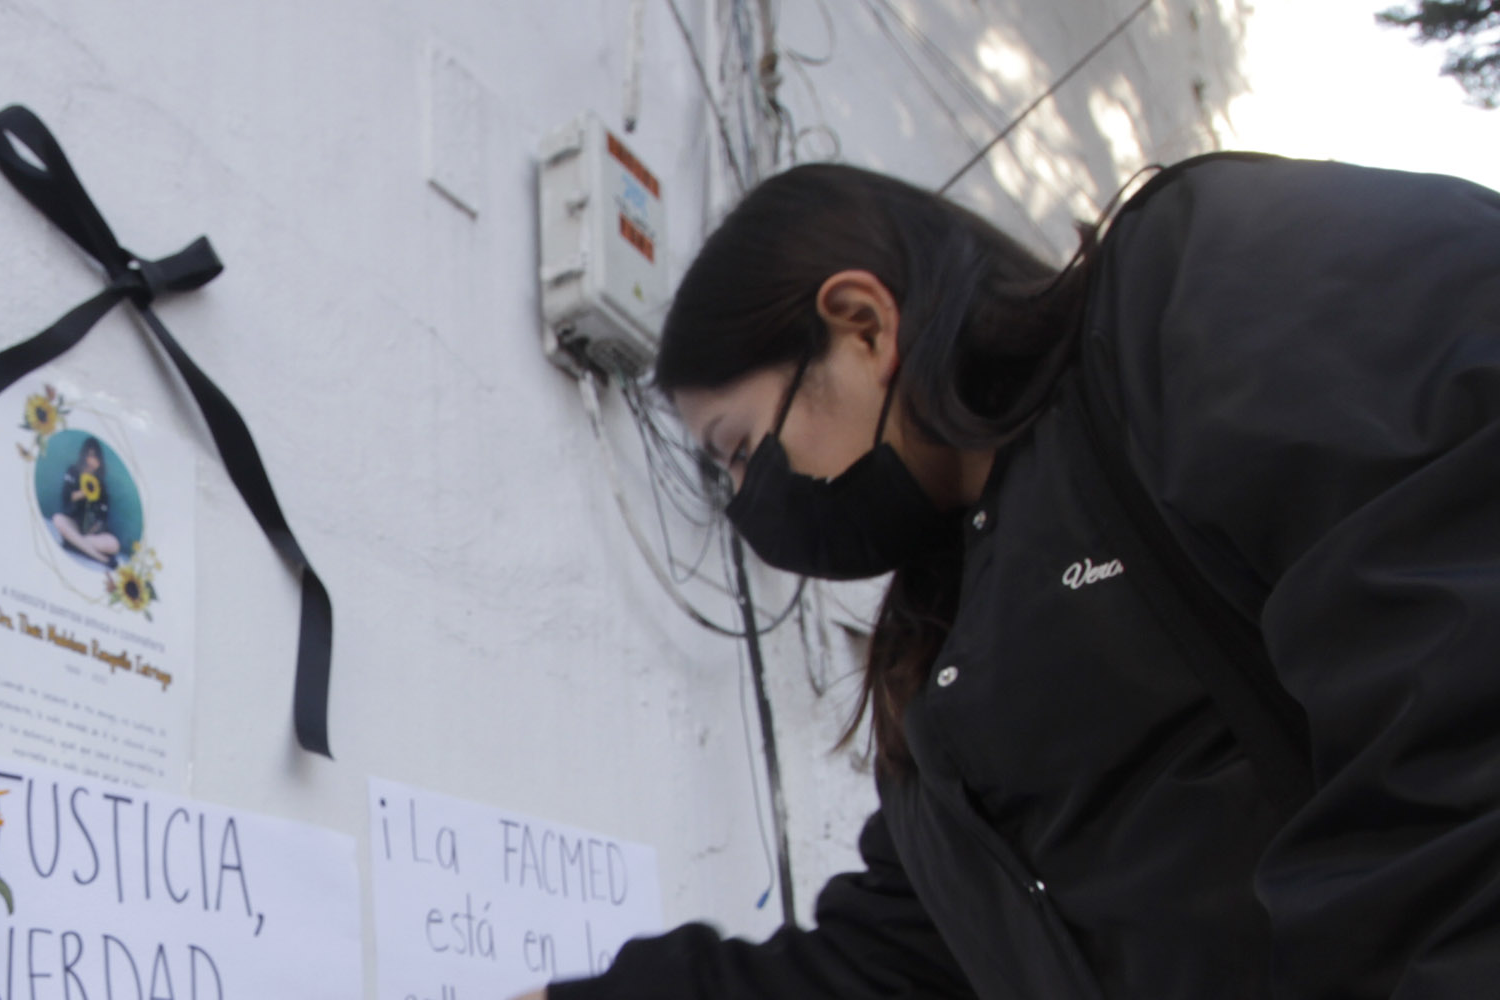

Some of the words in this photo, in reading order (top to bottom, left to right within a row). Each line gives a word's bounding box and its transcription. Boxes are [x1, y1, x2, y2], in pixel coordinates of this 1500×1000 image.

[499, 817, 629, 906] FACMED
[425, 892, 497, 961] está
[522, 929, 558, 978] en
